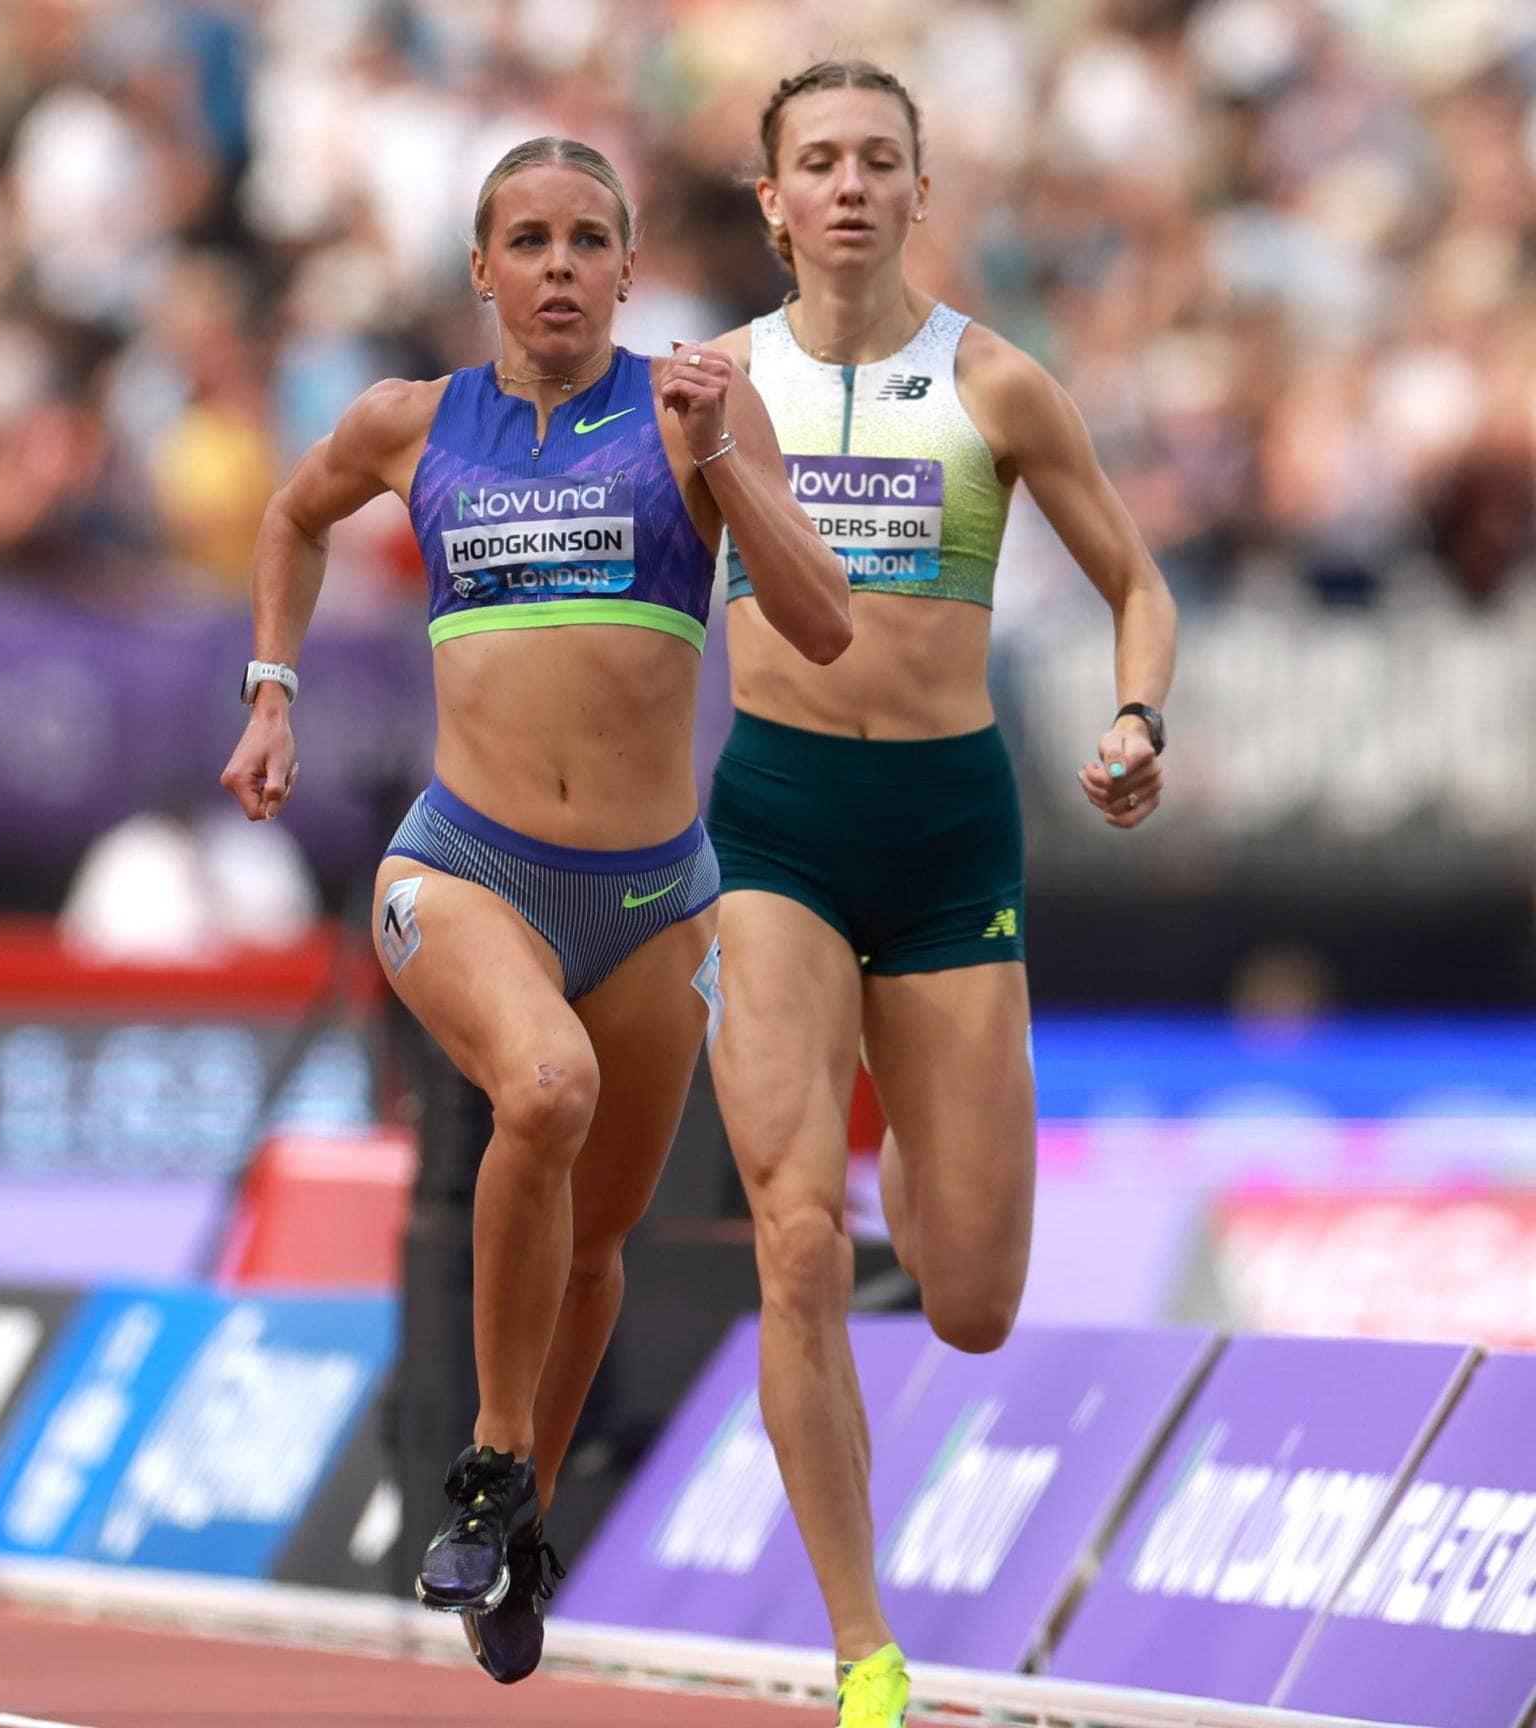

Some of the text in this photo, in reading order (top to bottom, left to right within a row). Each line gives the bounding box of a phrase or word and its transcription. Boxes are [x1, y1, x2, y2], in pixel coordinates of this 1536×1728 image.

[457, 486, 605, 520] Novuna
[811, 518, 931, 538] DERS-BOL
[452, 529, 622, 563] HODGKINSON
[840, 554, 915, 576] NDON
[506, 568, 609, 589] LONDON
